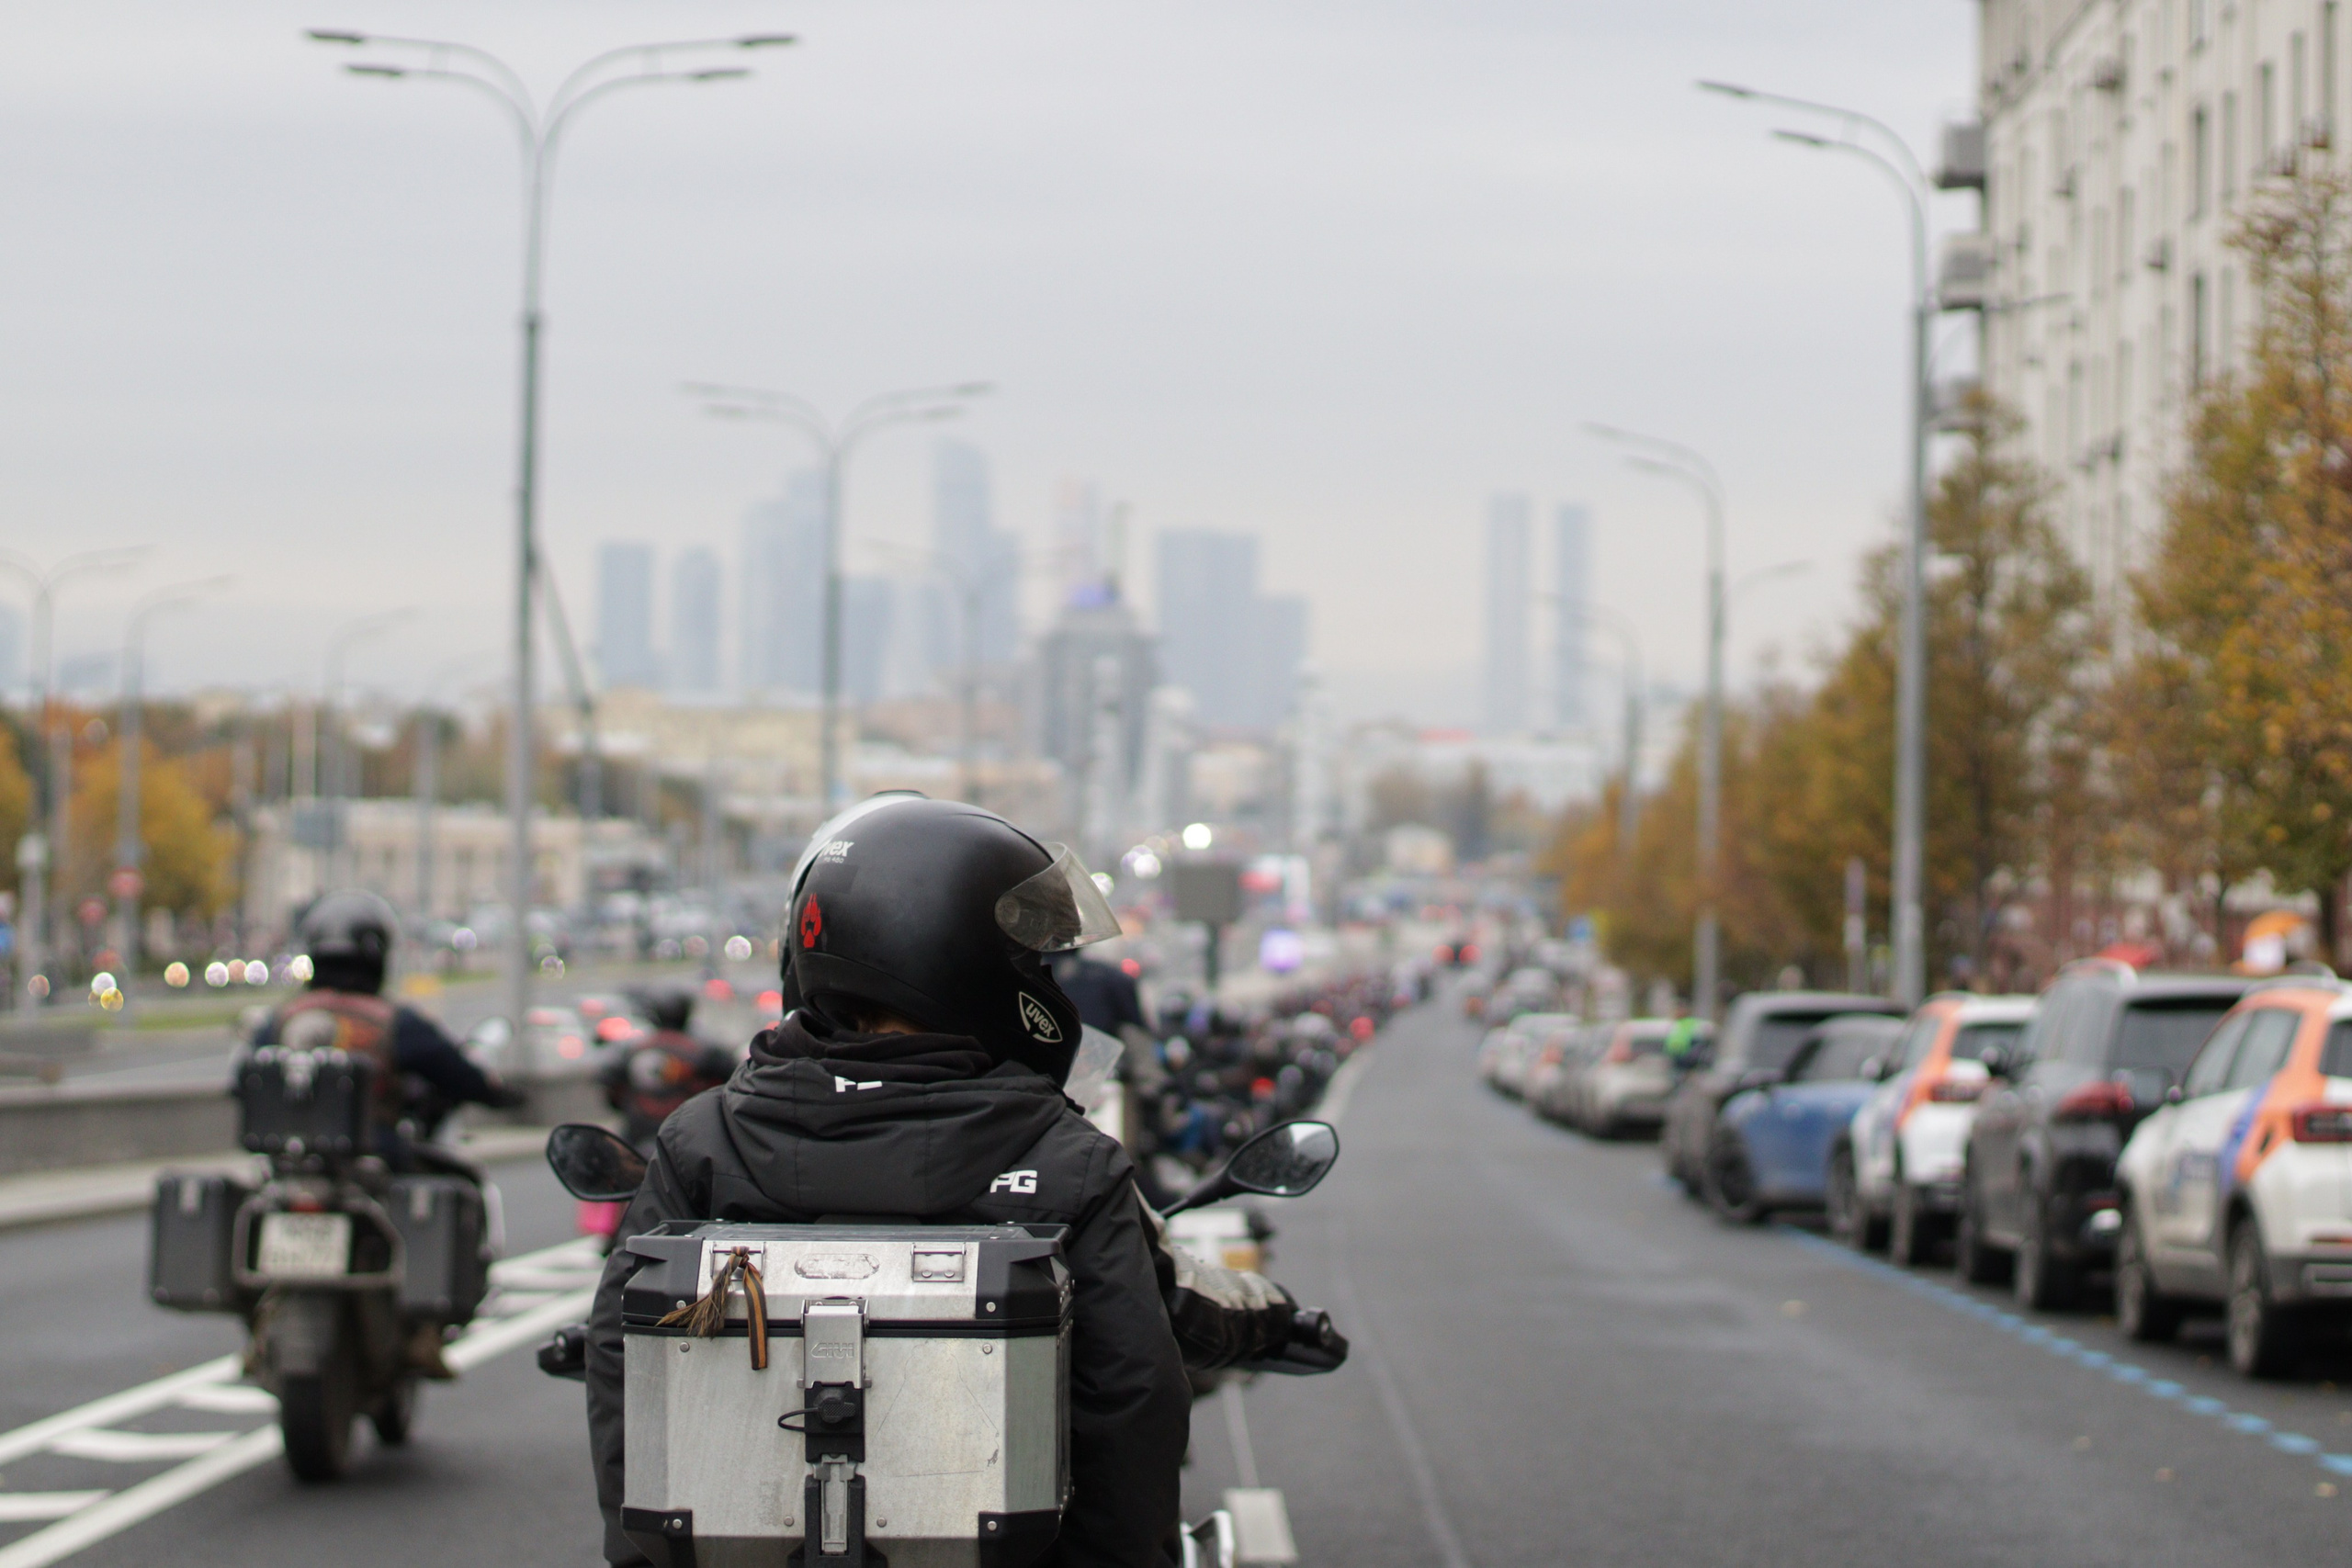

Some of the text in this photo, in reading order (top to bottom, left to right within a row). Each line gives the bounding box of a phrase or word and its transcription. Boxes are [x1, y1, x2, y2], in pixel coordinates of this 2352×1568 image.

[819, 840, 854, 857] vex
[1025, 1002, 1055, 1038] uvex
[810, 1341, 854, 1359] GIVI
